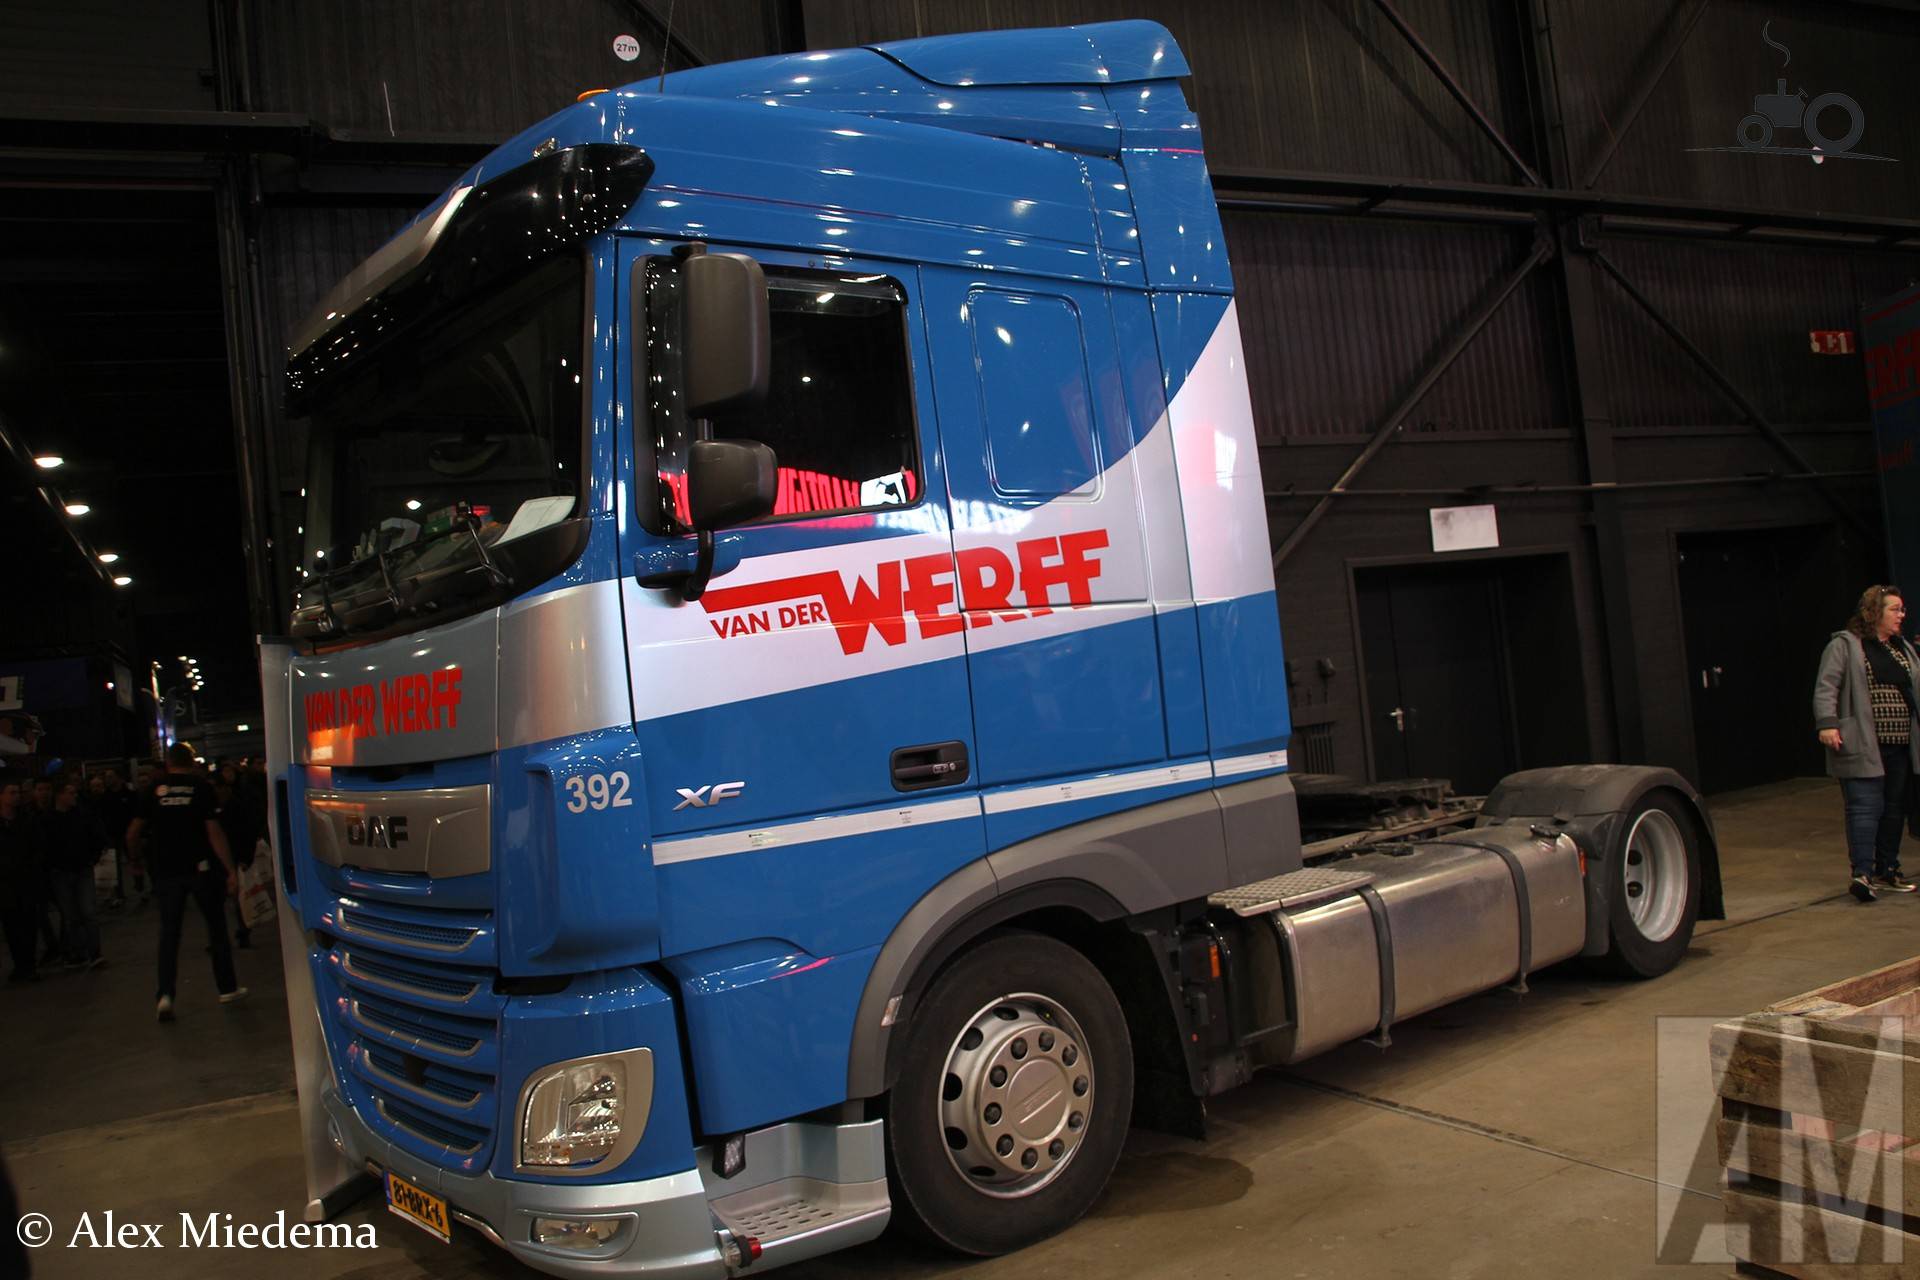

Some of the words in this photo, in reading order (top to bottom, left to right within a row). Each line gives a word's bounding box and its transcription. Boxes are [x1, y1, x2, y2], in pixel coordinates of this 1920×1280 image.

[616, 43, 637, 52] 27m
[822, 529, 1109, 655] WERFF
[710, 610, 771, 640] VAN
[778, 601, 827, 629] DER
[304, 690, 336, 742] VAN
[338, 684, 377, 740] DER
[381, 668, 463, 737] WERFF
[565, 770, 633, 814] 392
[672, 781, 746, 811] XF
[345, 815, 409, 849] DAF
